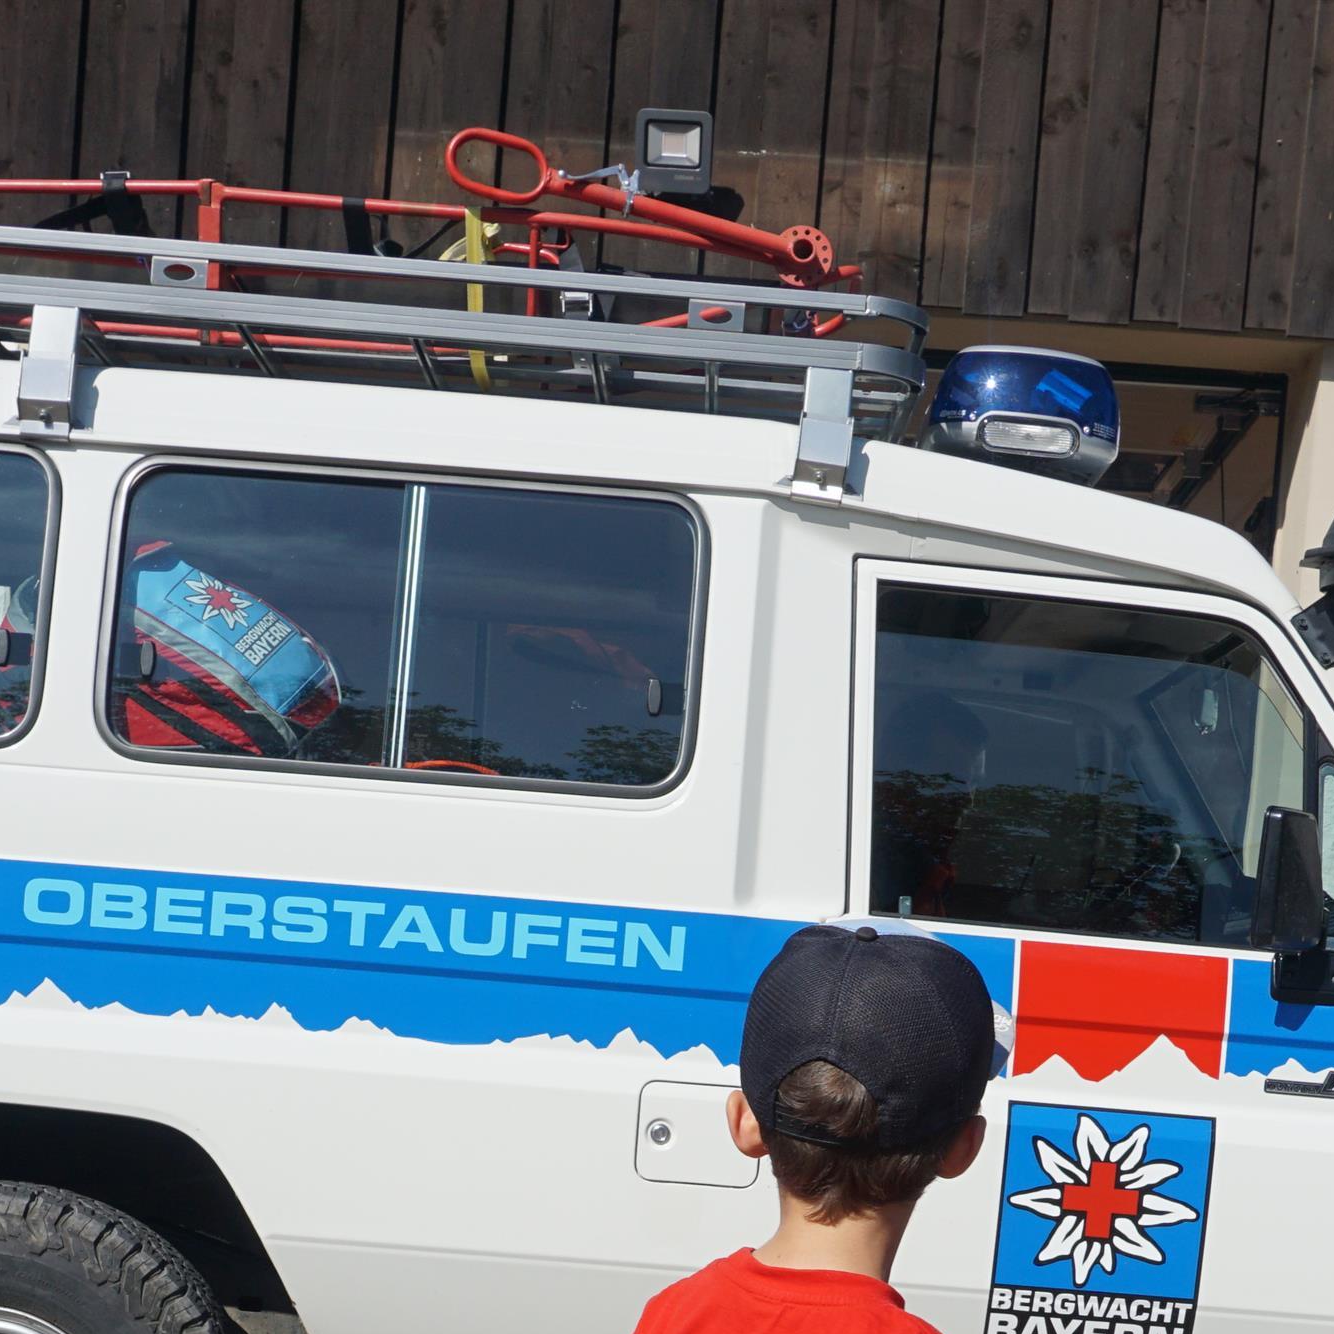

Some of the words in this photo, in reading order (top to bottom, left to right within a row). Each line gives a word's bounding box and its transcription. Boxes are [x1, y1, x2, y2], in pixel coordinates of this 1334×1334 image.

[243, 620, 292, 665] BAYERN
[22, 877, 687, 972] OBERSTAUFEN
[990, 1287, 1193, 1325] BERGWACHT
